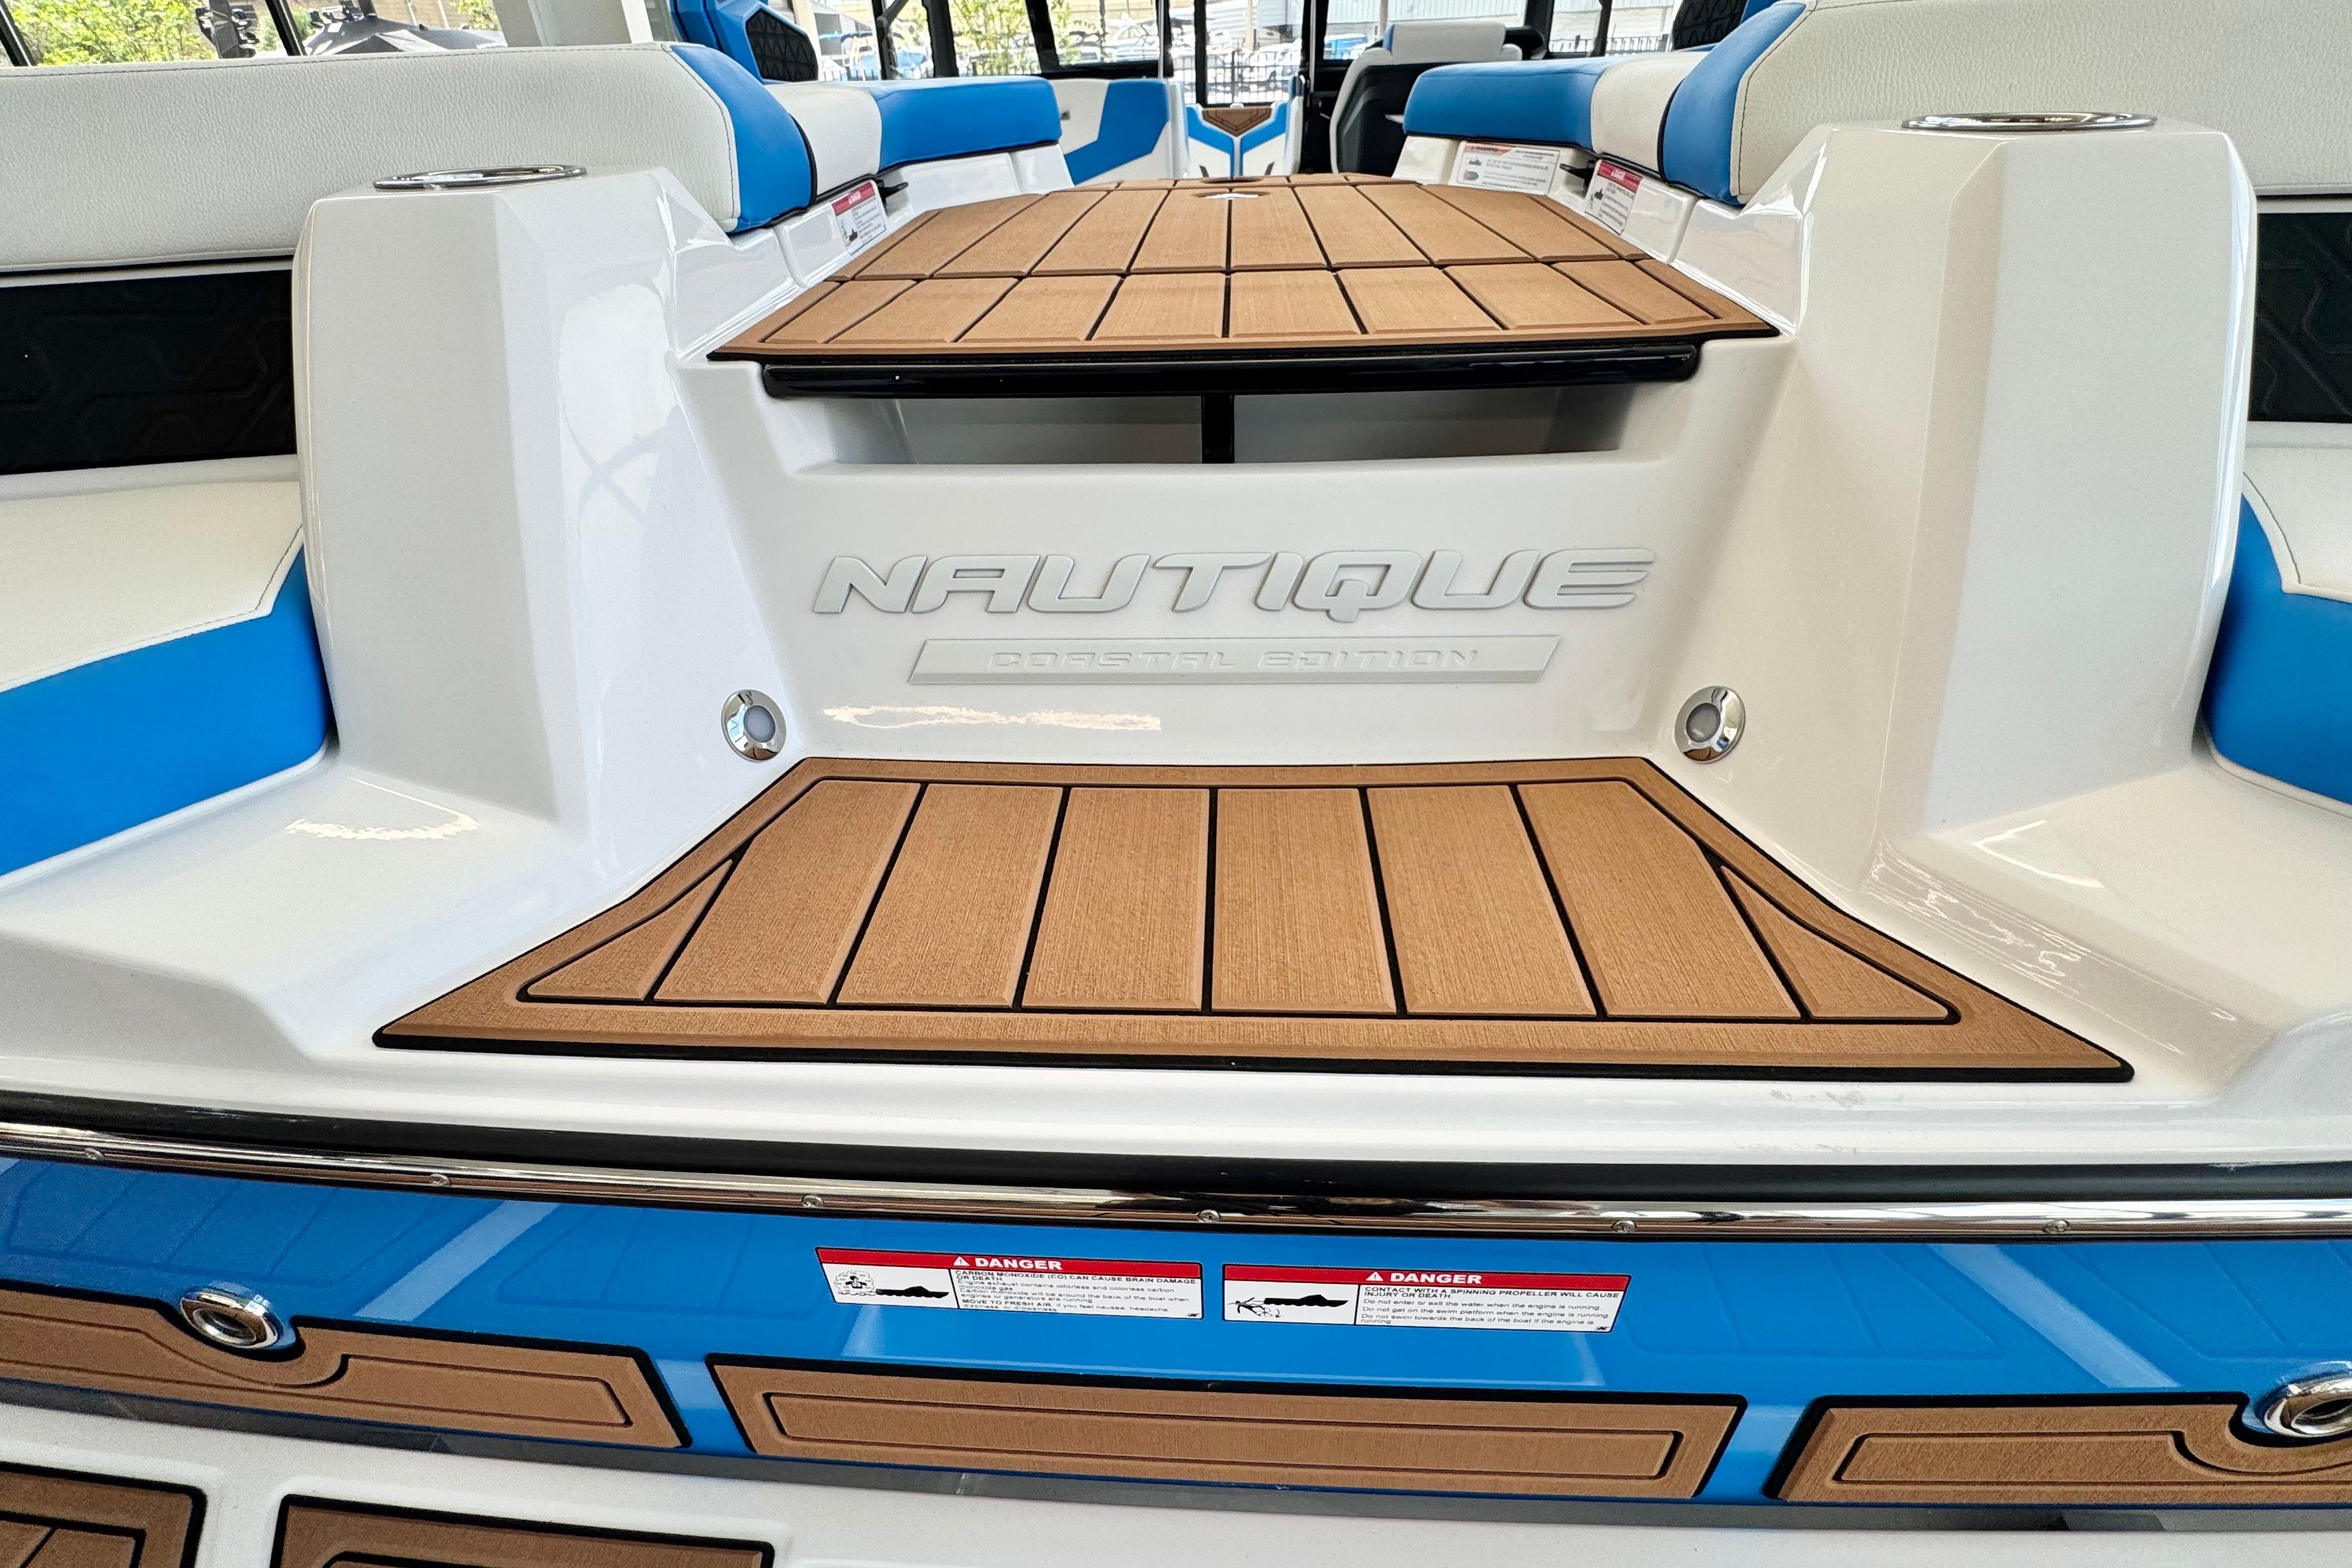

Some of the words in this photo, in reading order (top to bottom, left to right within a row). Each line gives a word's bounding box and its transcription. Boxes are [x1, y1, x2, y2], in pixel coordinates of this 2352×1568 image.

[813, 548, 1656, 622] NAUTIQUE
[988, 651, 1236, 670] COASTAL
[1258, 649, 1479, 669] EDITION
[975, 1258, 1062, 1270] DANGER
[1390, 1273, 1482, 1283] DANGER
